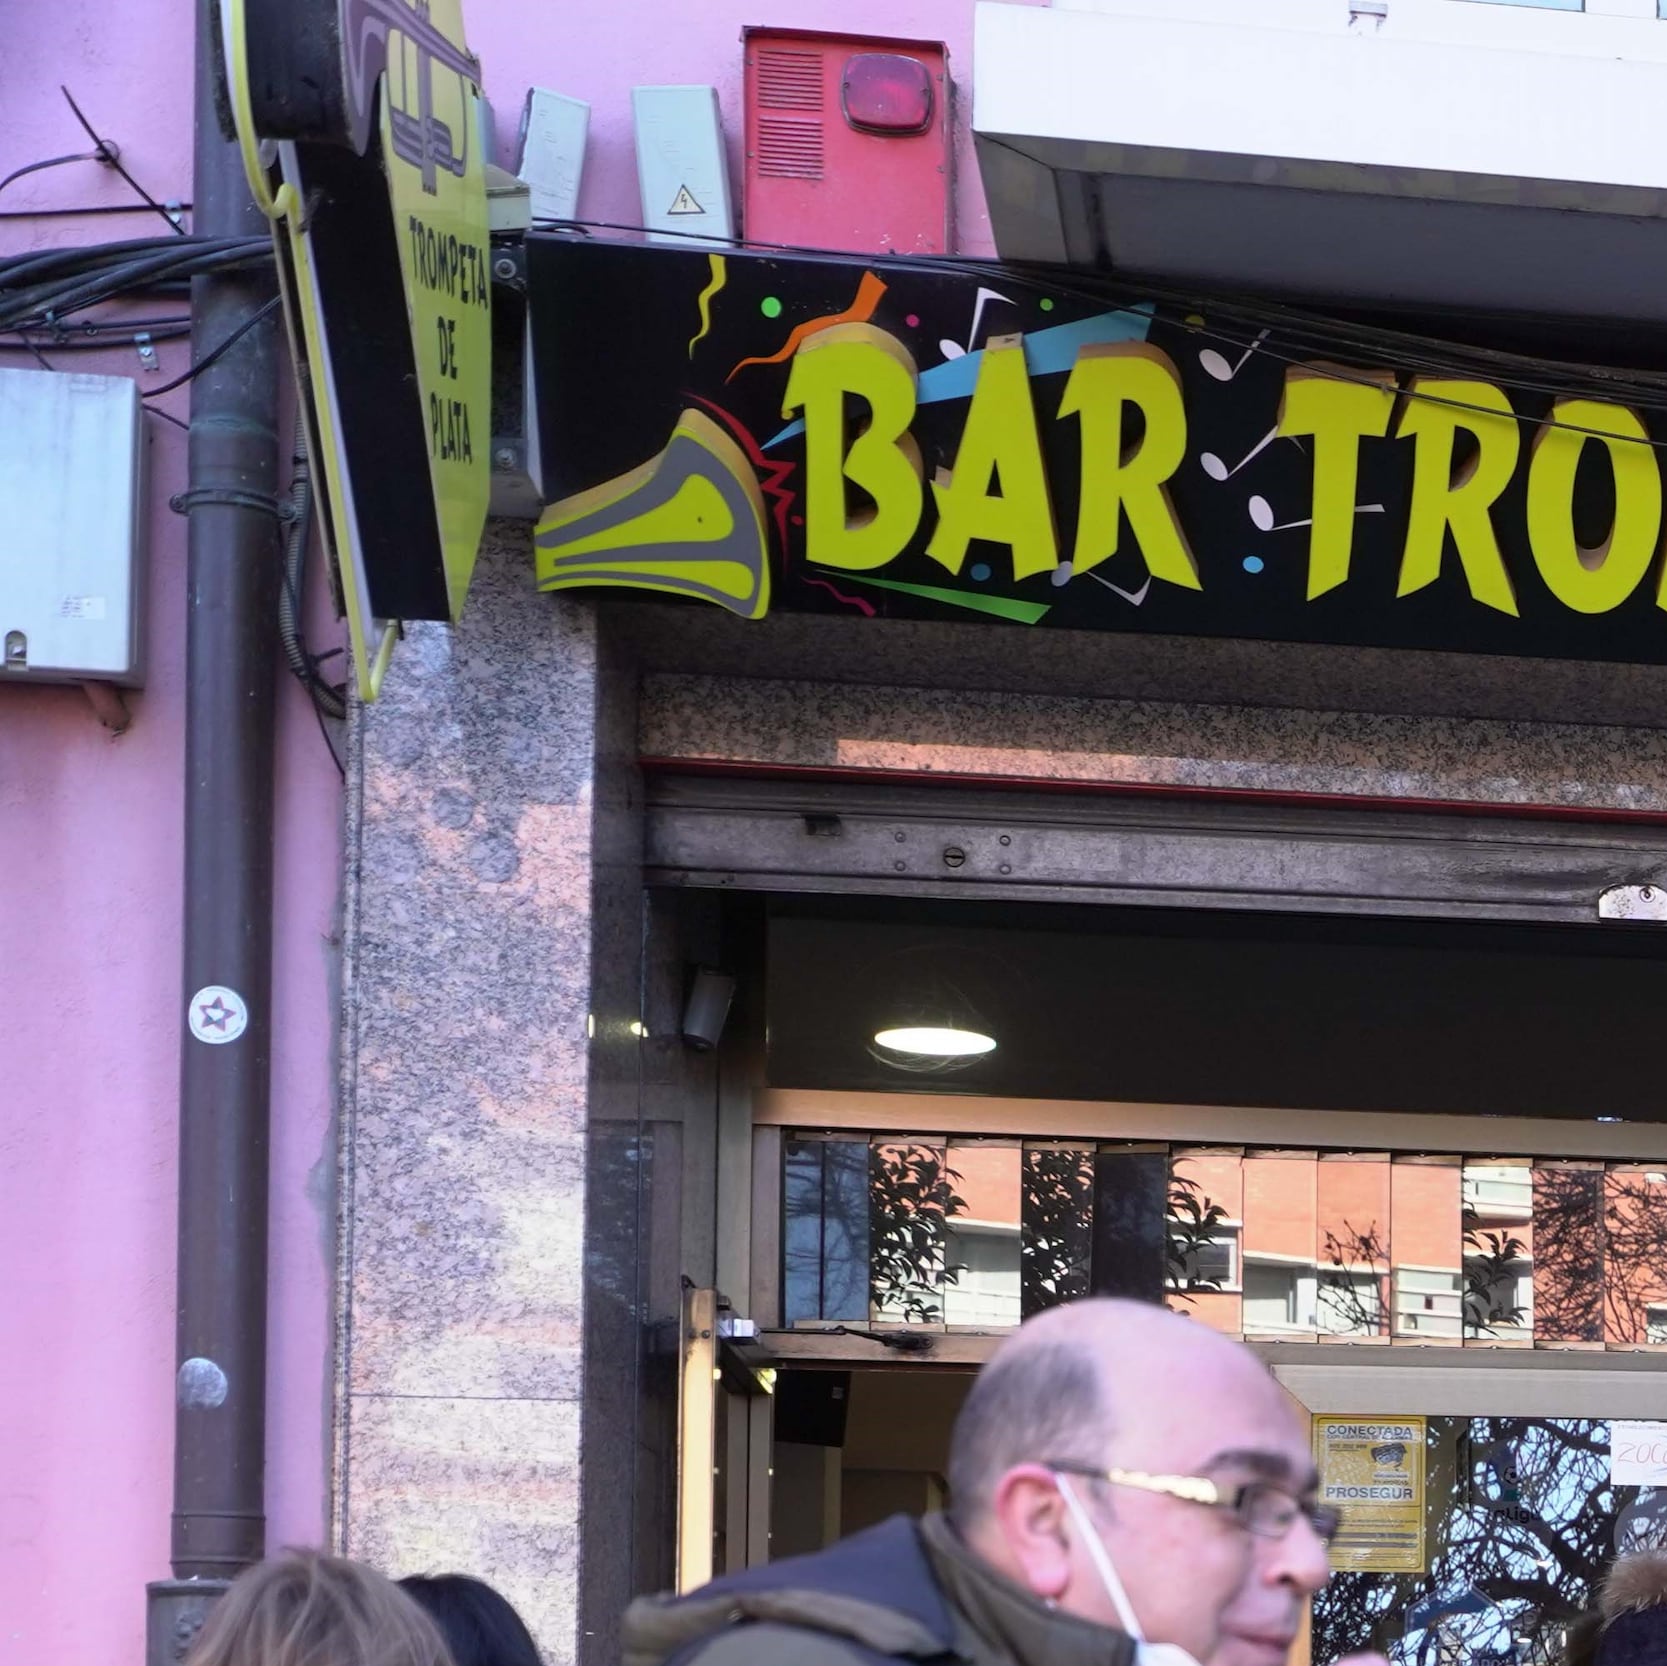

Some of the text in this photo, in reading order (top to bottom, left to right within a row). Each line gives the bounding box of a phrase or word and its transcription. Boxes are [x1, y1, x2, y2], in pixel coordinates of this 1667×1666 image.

[409, 215, 488, 310] TROMPETA
[437, 316, 457, 379] DE
[430, 391, 472, 464] PLATA
[782, 324, 1202, 592] BAR
[1327, 1425, 1413, 1437] CONECTADA
[1325, 1487, 1414, 1499] PROSEGUR
